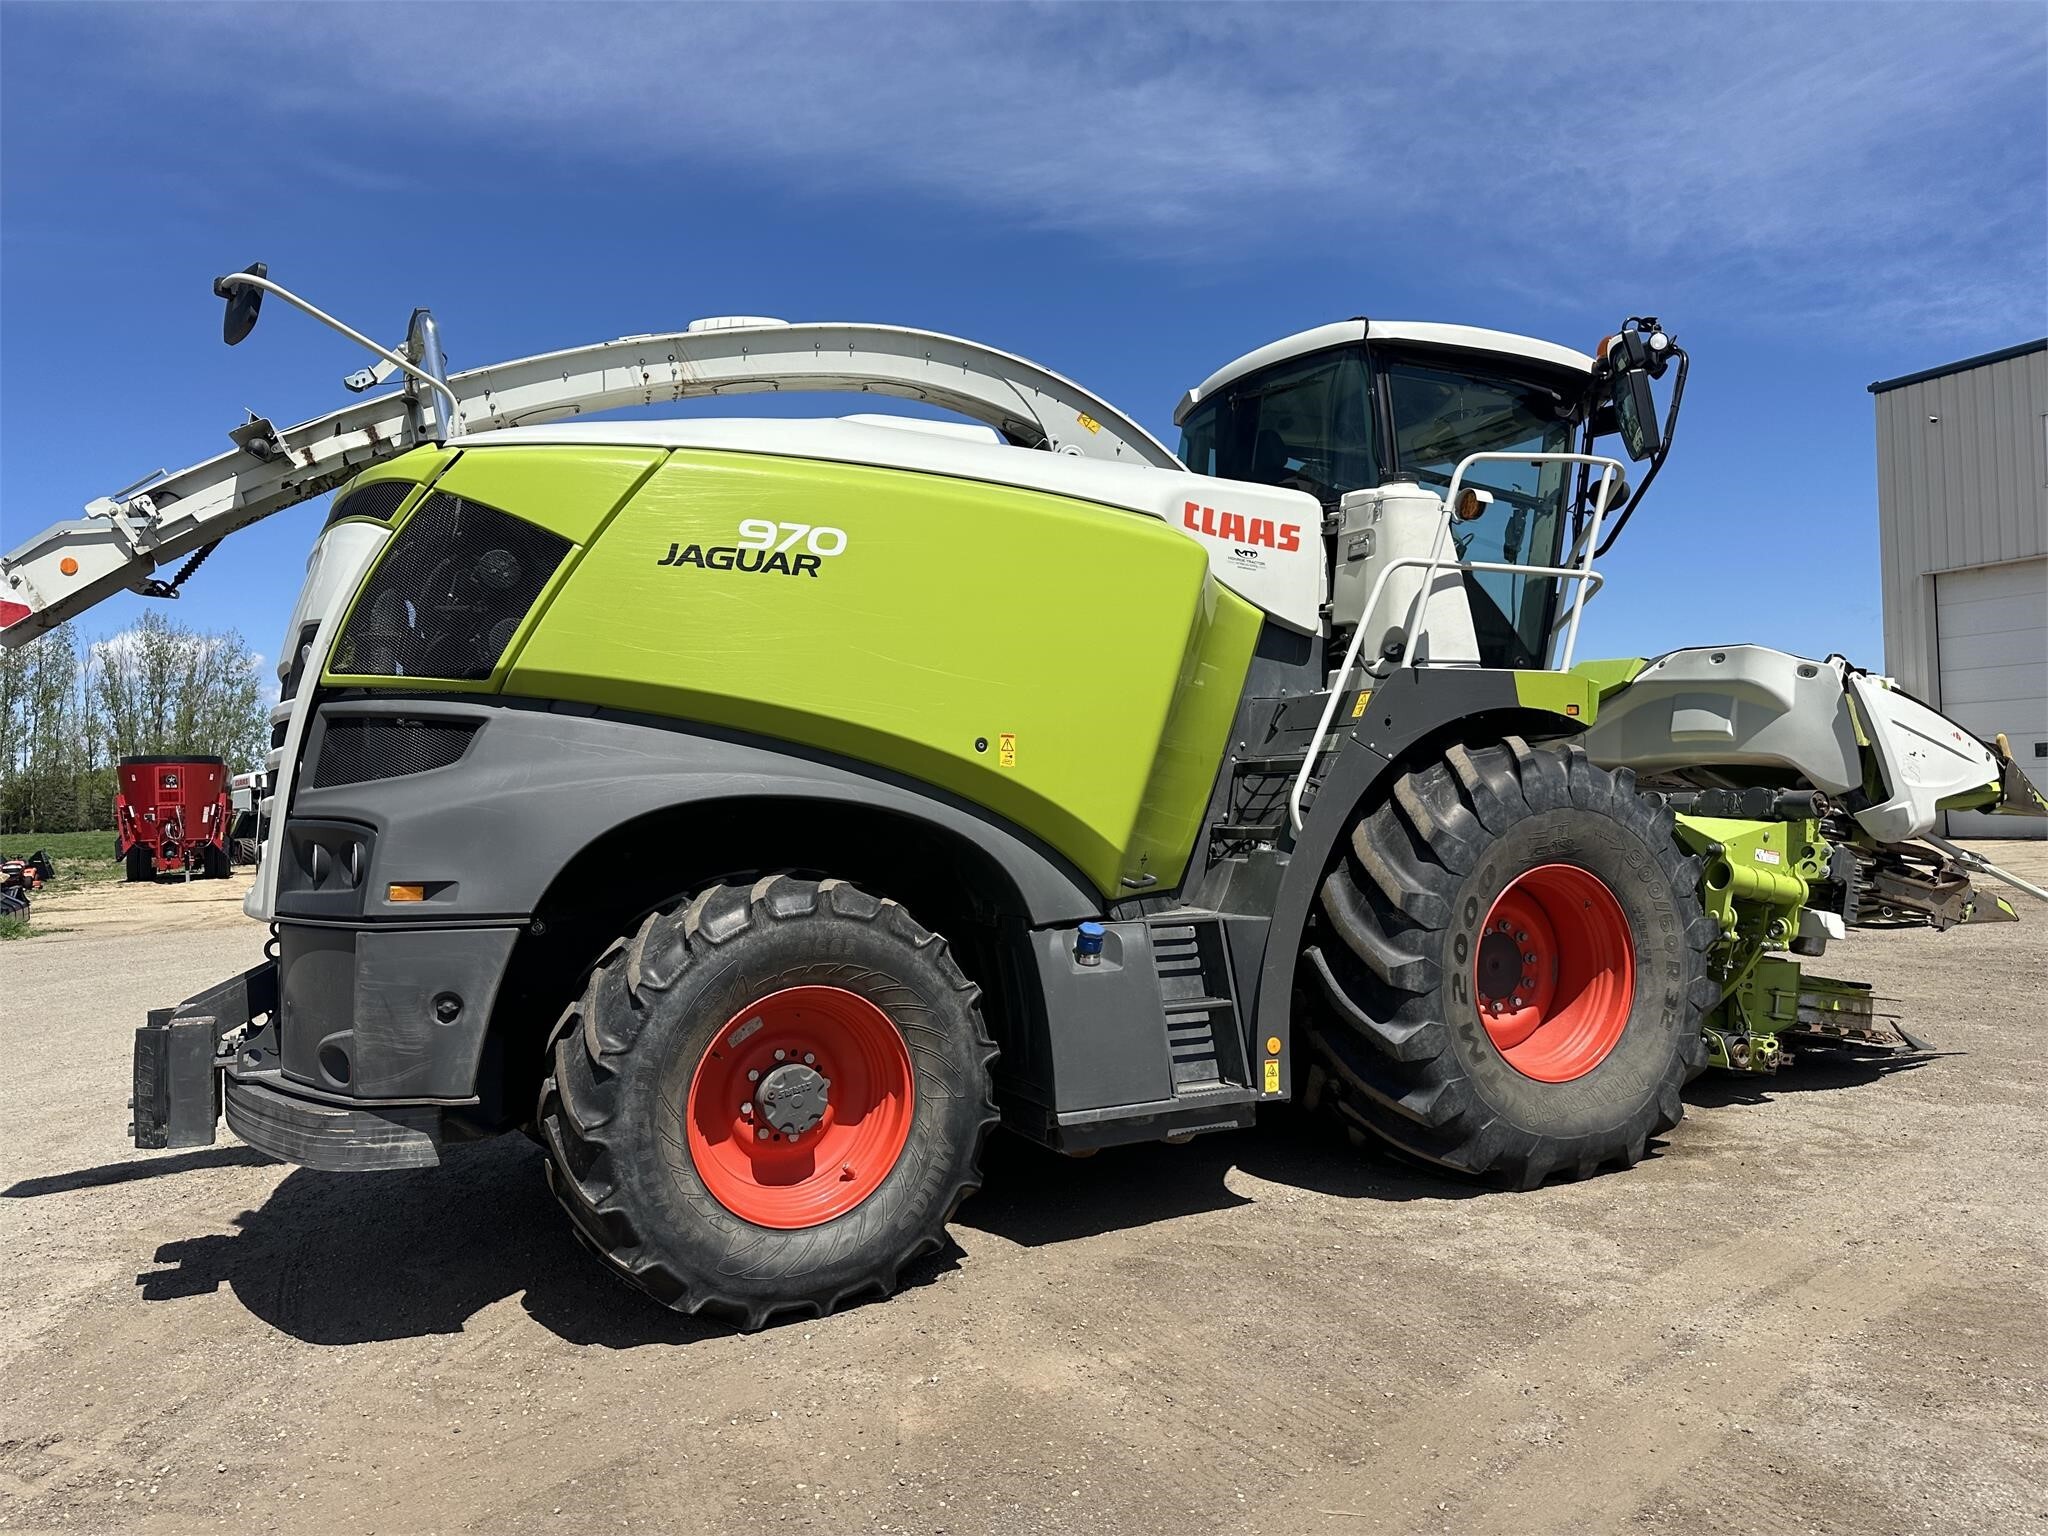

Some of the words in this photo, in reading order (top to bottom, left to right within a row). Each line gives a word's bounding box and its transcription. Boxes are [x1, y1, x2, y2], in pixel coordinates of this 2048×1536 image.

[737, 518, 847, 557] 970
[1184, 501, 1300, 552] CLAAS
[657, 543, 822, 578] JAGUAR
[1452, 864, 1496, 1004] 2000
[1521, 1069, 1650, 1127] TRELLEBORG
[898, 1127, 955, 1230] Mitas
